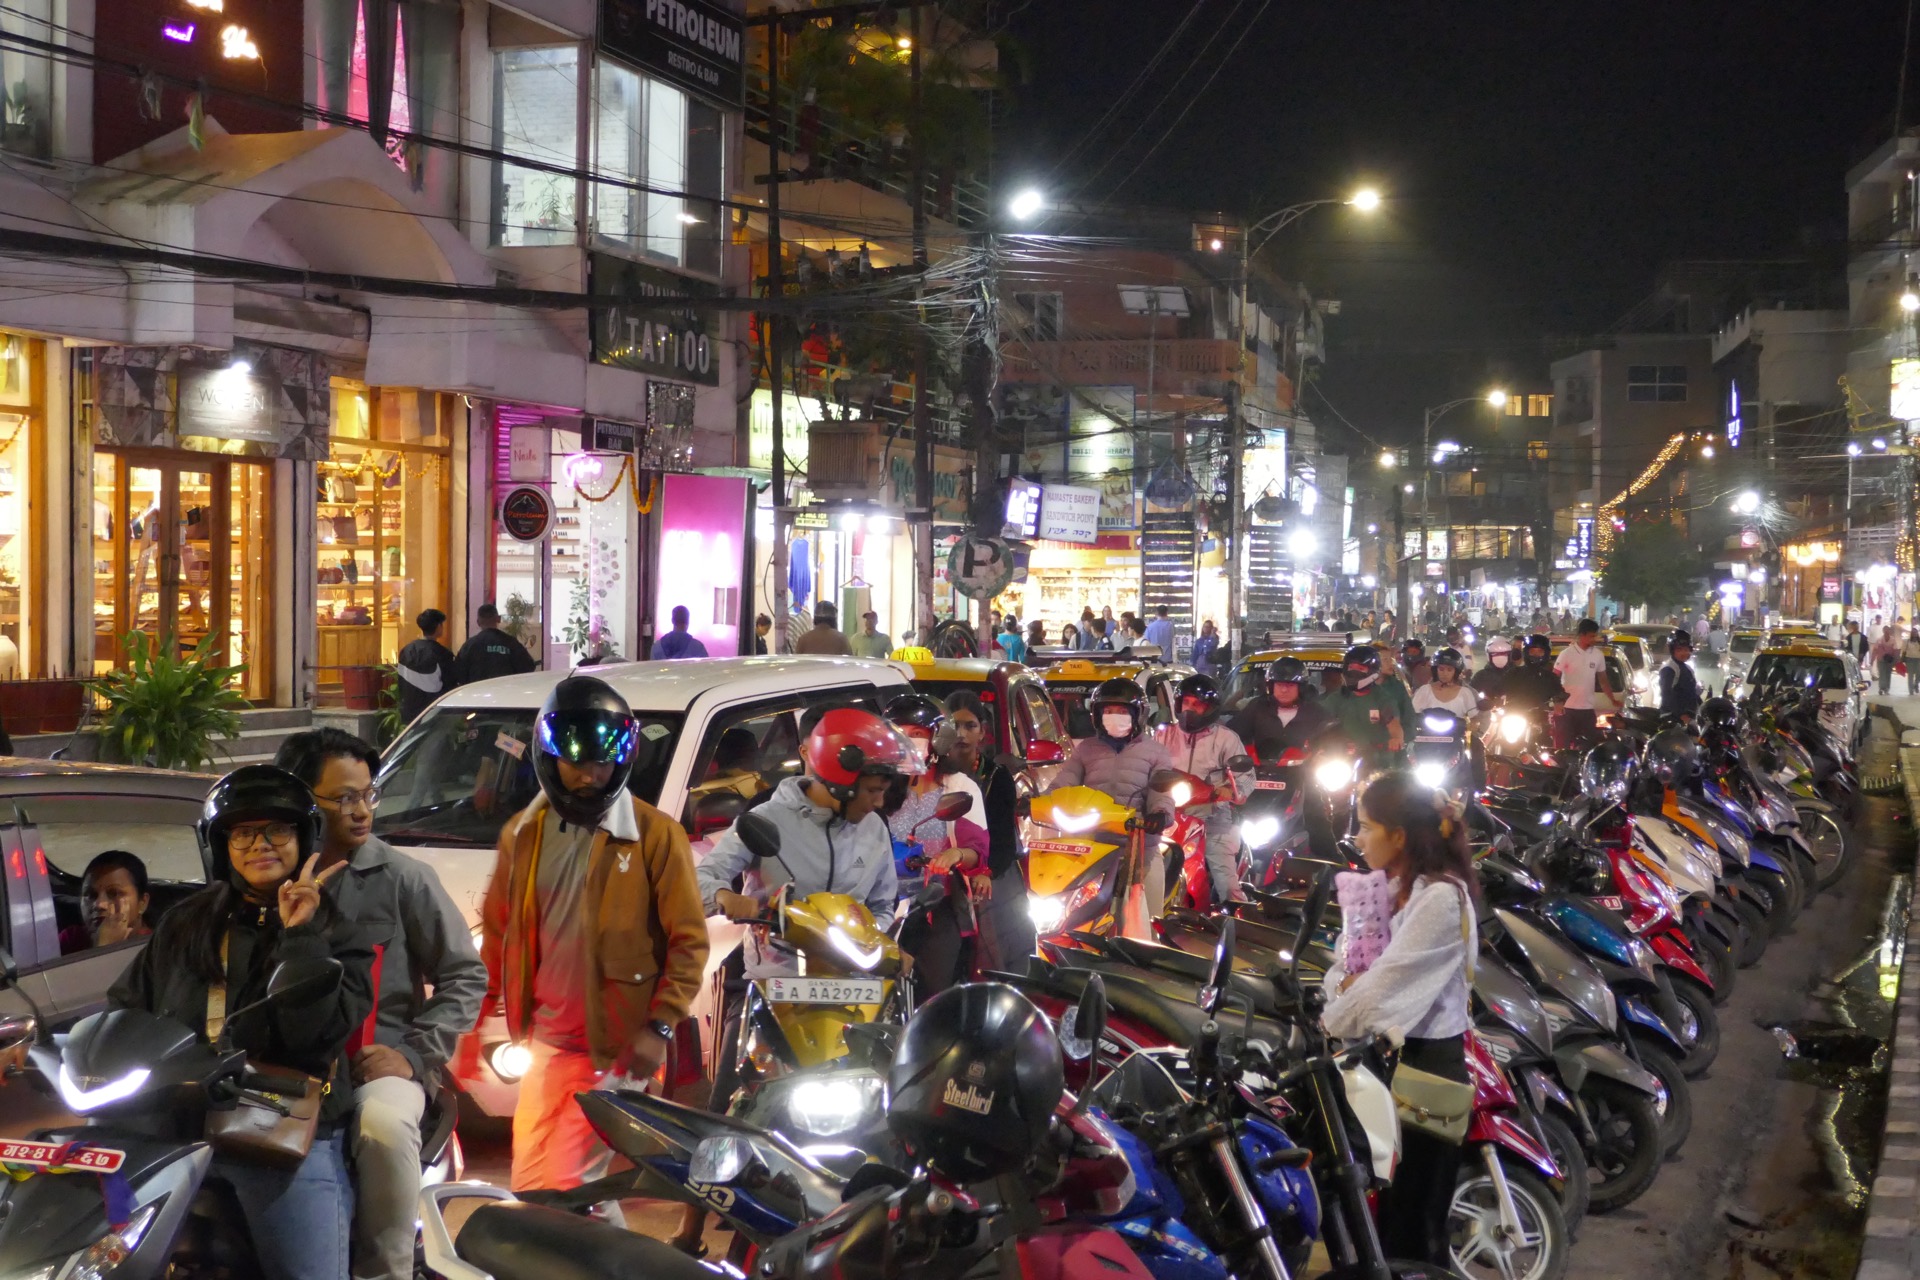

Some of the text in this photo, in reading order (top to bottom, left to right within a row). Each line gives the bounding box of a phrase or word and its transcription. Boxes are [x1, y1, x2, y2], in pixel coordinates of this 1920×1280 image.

[645, 0, 740, 62] PETROLEUM
[667, 51, 719, 86] RESTRO & BAR
[199, 387, 264, 410] WOEN
[597, 422, 633, 436] PETROLEUM
[608, 438, 622, 450] BAR
[1047, 492, 1096, 505] NAMASTE BAKERY
[1046, 510, 1076, 522] SANDWICH
[1077, 513, 1095, 524] POINT
[1105, 517, 1126, 526] BATH
[896, 651, 925, 661] TAXI
[790, 987, 799, 999] A
[943, 1077, 995, 1115] Steelbird
